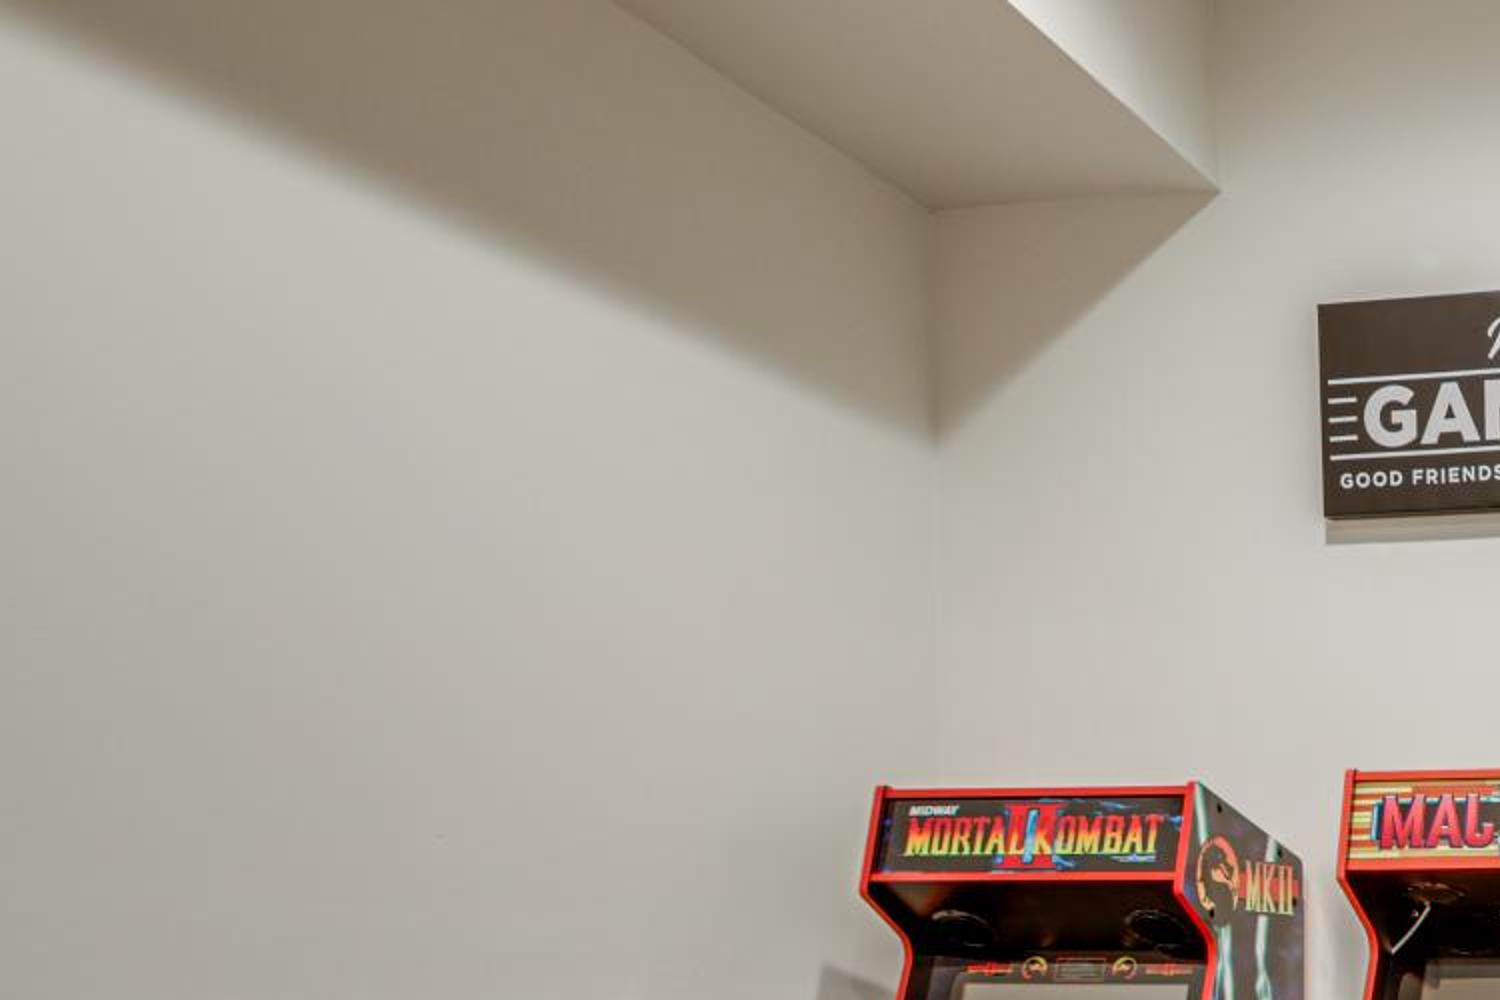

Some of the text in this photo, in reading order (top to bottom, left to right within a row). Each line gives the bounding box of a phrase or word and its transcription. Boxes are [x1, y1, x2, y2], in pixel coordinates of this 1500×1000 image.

[1339, 472, 1404, 490] GOOD
[909, 805, 960, 816] MIDWAY
[903, 814, 1165, 856] MORTAL KOMBAT
